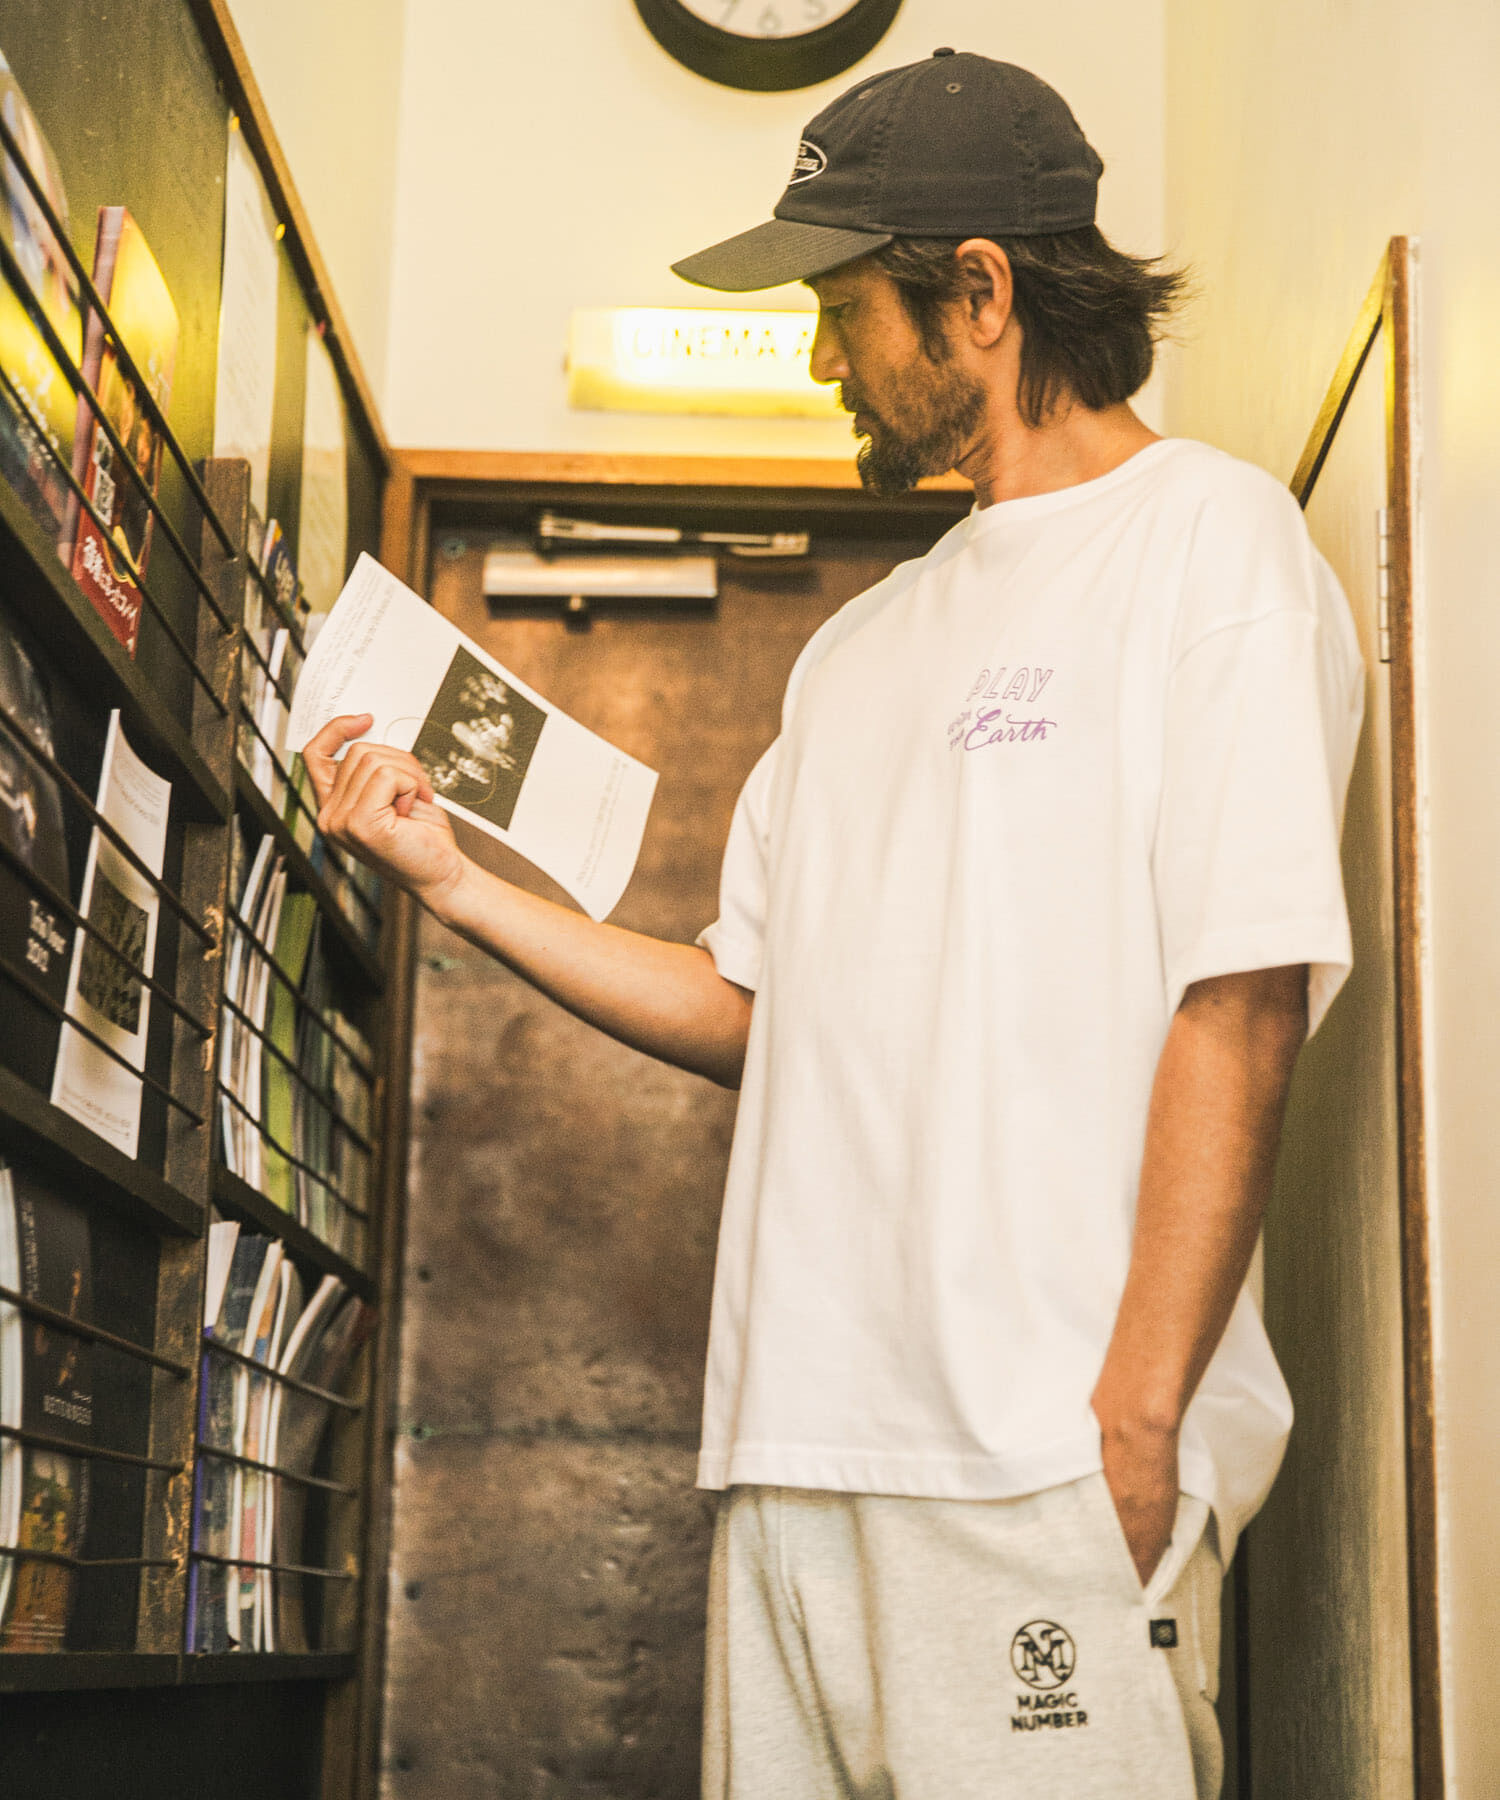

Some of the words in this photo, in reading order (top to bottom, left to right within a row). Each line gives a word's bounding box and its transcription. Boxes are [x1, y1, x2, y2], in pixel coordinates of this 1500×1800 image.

[756, 3, 783, 33] 6
[632, 326, 777, 361] CINEMA
[966, 666, 1054, 702] PLAY
[964, 706, 1058, 751] Earth
[1017, 1692, 1078, 1711] MAGIC
[1010, 1710, 1089, 1733] NUMBER
